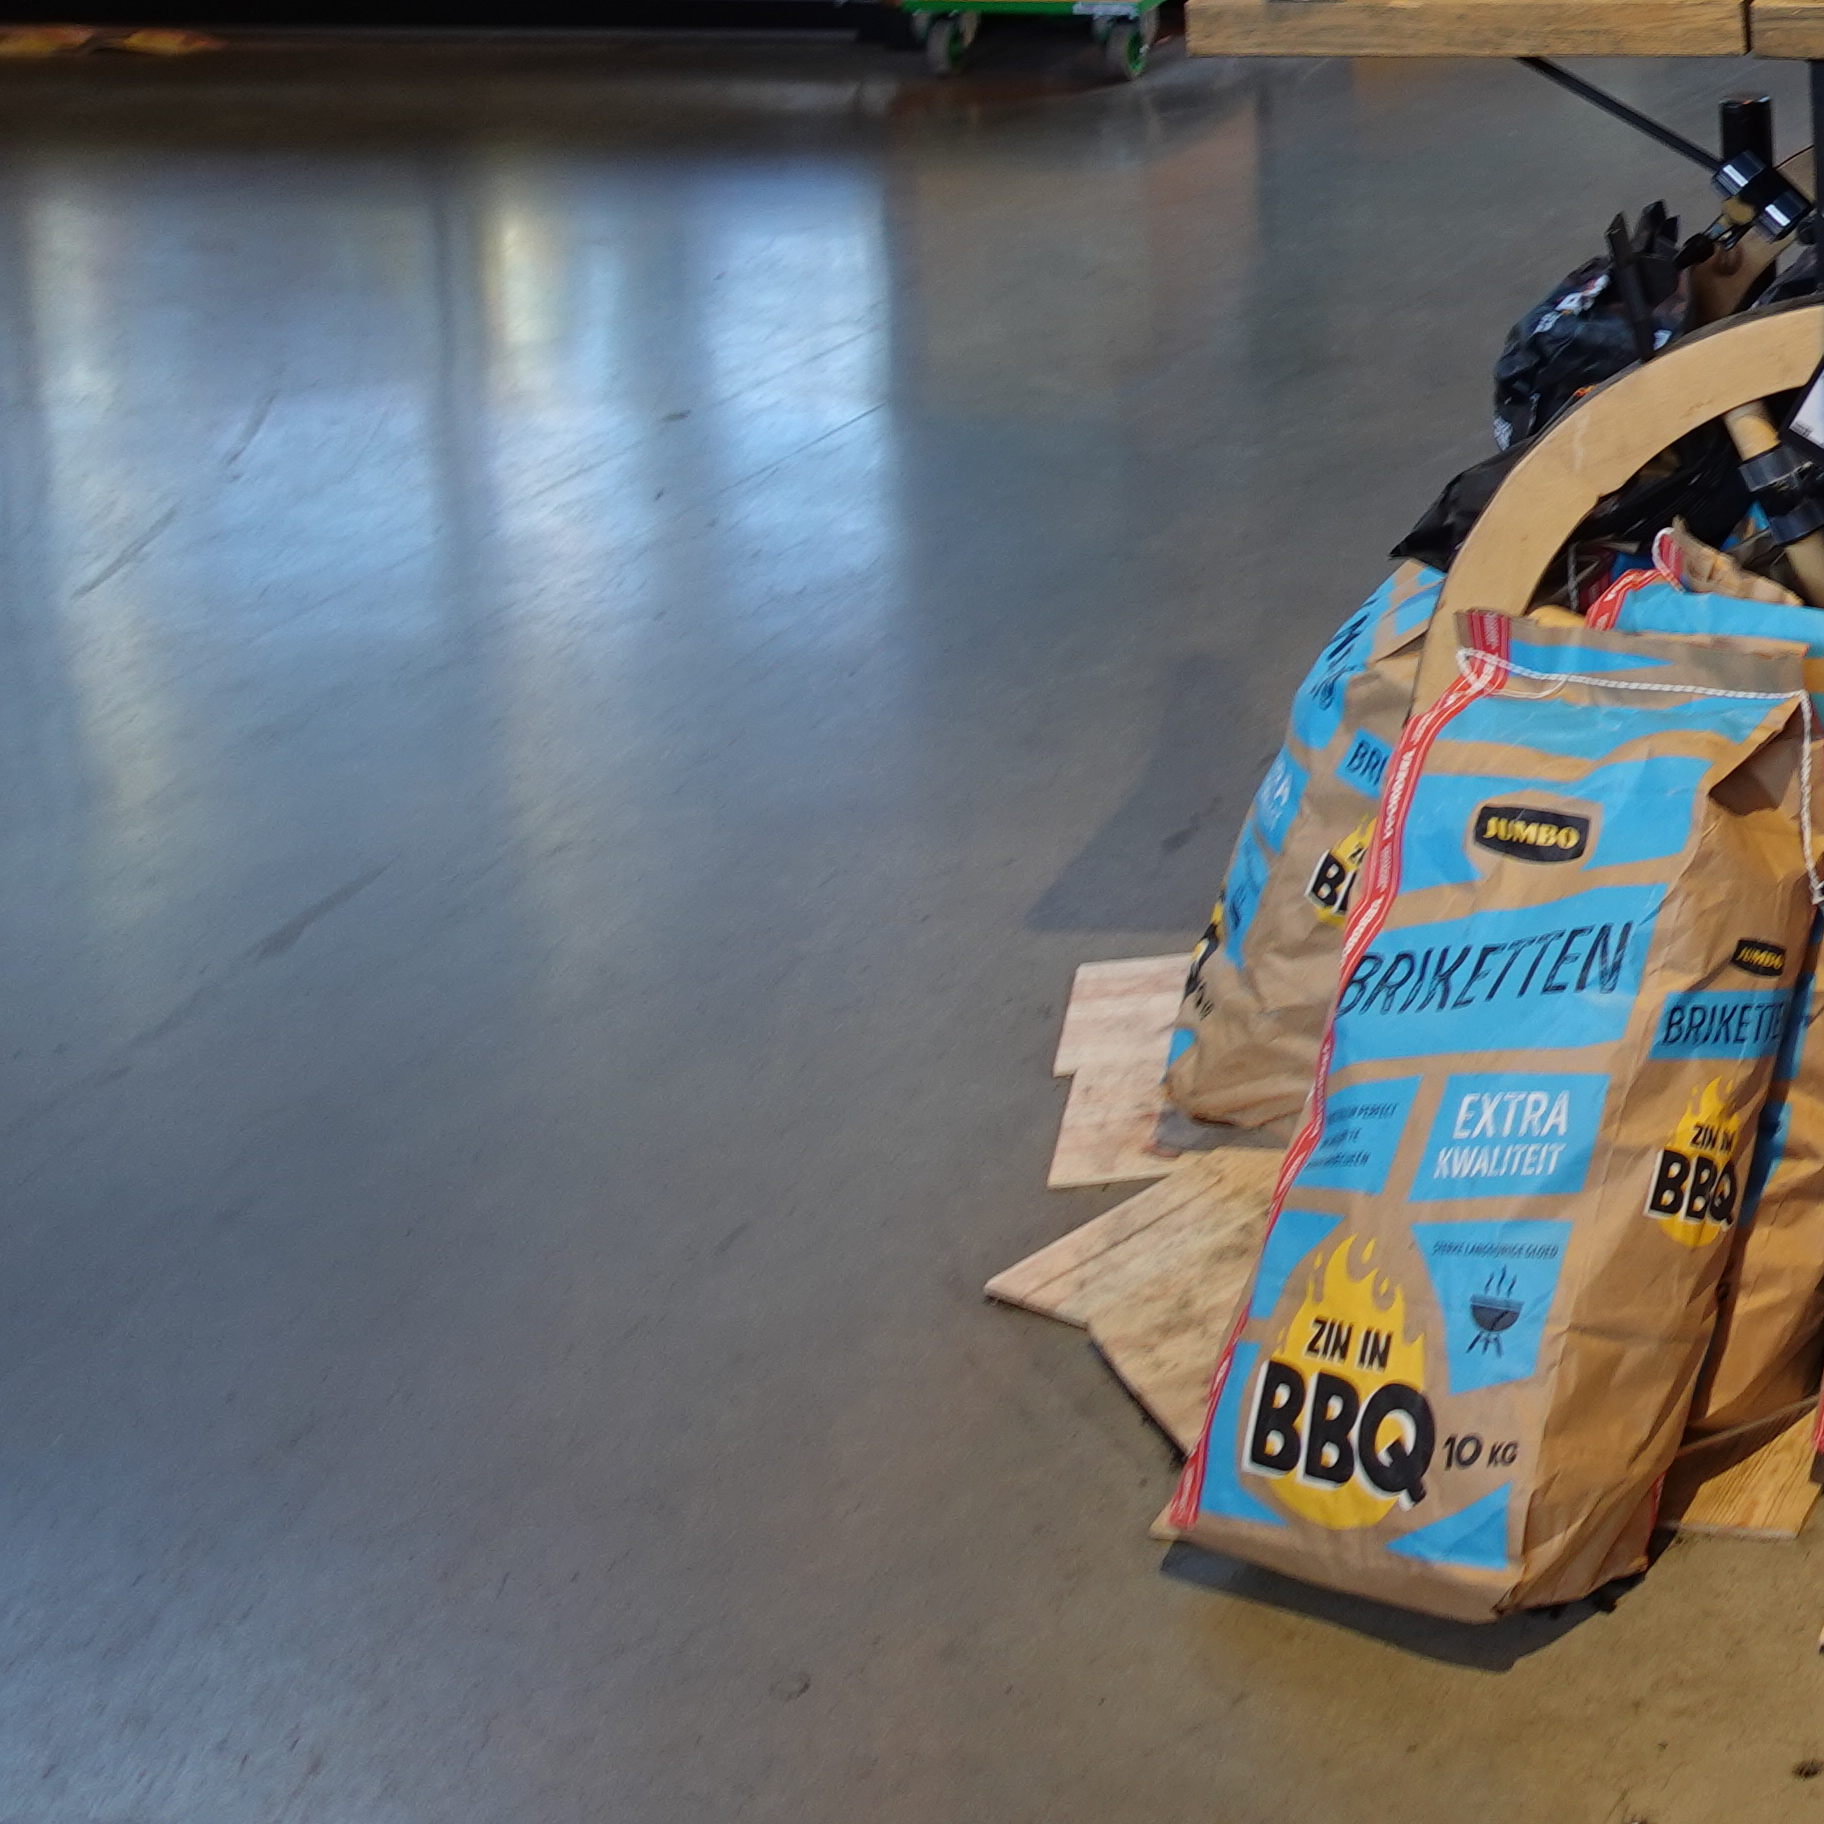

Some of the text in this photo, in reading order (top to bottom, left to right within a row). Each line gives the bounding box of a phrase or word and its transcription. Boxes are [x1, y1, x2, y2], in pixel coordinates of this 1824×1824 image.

[1482, 814, 1582, 852] JUMBO
[1335, 920, 1634, 1020] BRIKETTEN
[1740, 944, 1784, 971] JUMBO
[1451, 1090, 1570, 1141] EXTRA
[1692, 1124, 1717, 1150] ZIN
[1433, 1143, 1565, 1181] KWALITEIT
[1646, 1149, 1738, 1232] BBQ
[1305, 1317, 1394, 1372] ZIN IN
[1241, 1359, 1436, 1512] BBQ
[1443, 1434, 1518, 1471] 10 KG
